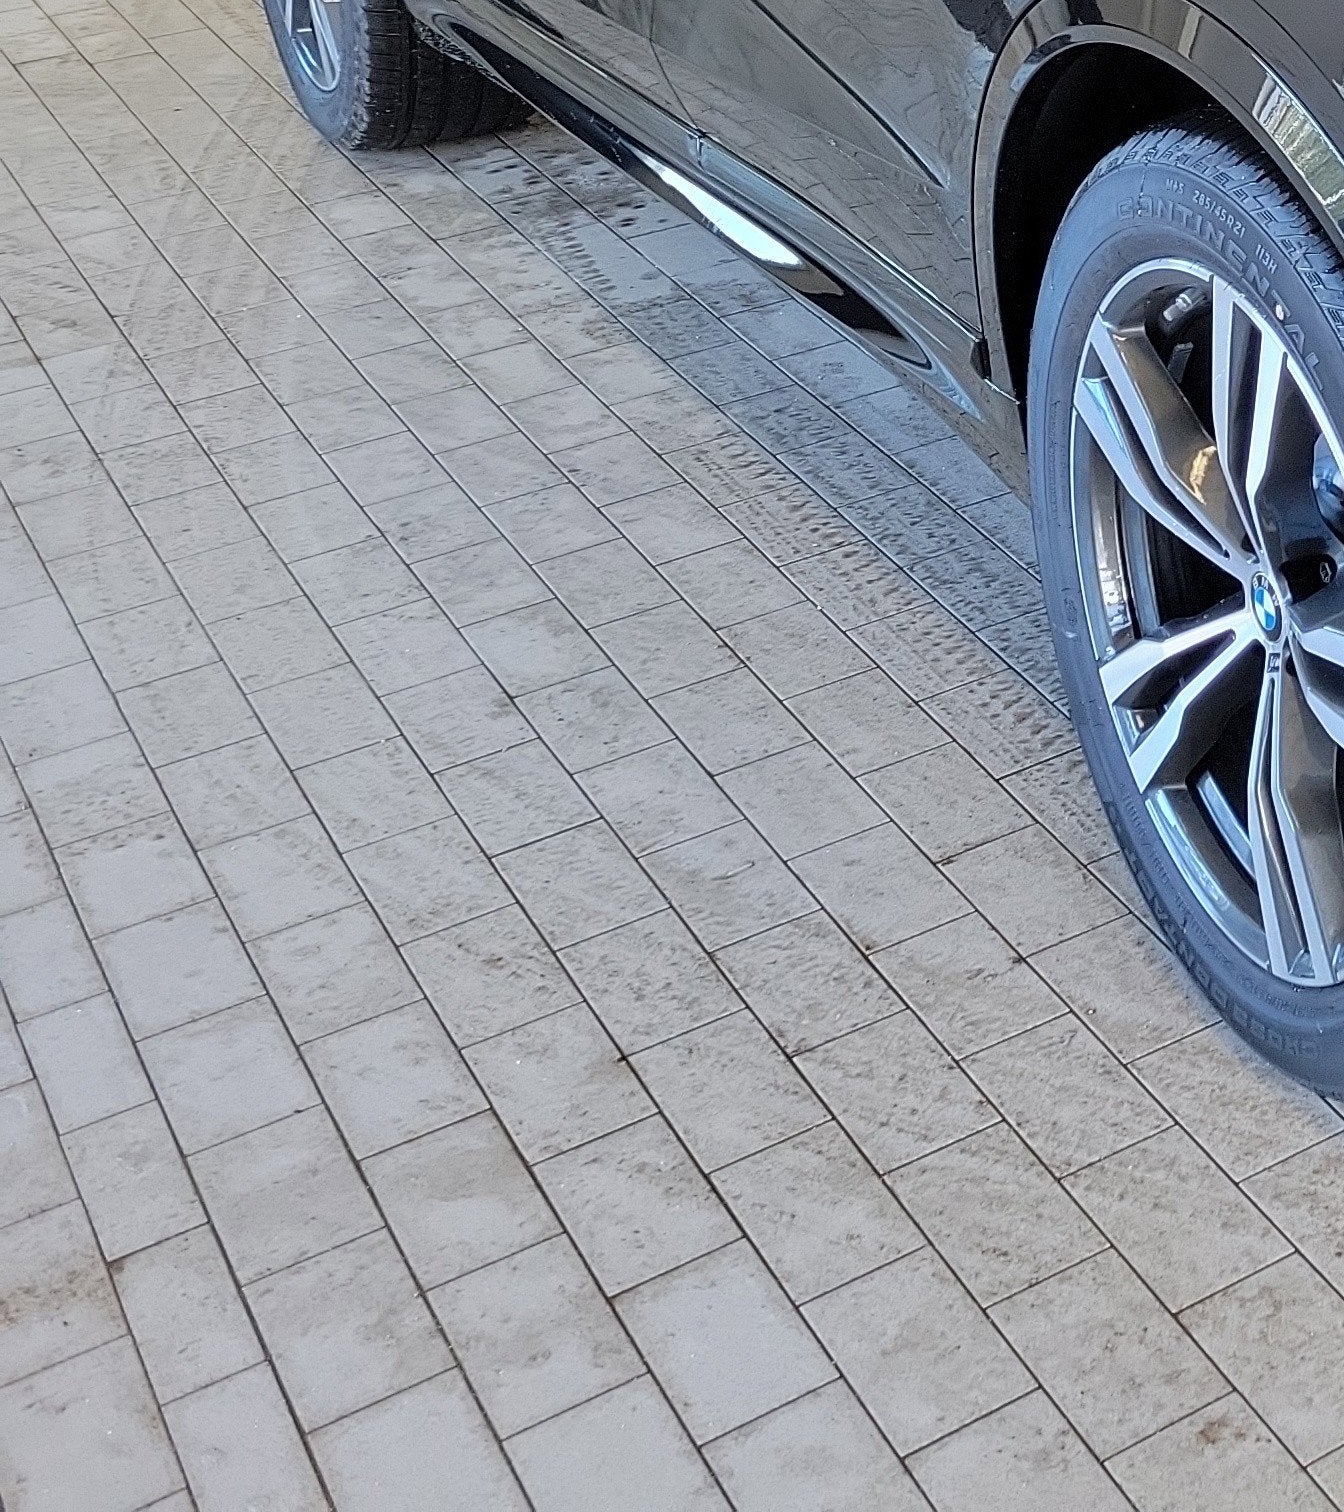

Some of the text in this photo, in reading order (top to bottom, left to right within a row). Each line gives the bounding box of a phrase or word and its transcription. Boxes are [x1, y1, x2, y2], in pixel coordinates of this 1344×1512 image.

[1191, 190, 1247, 238] 285/45R21
[1254, 244, 1279, 275] 113H
[1117, 195, 1324, 392] CONTINENTAL
[1252, 576, 1280, 607] BMW
